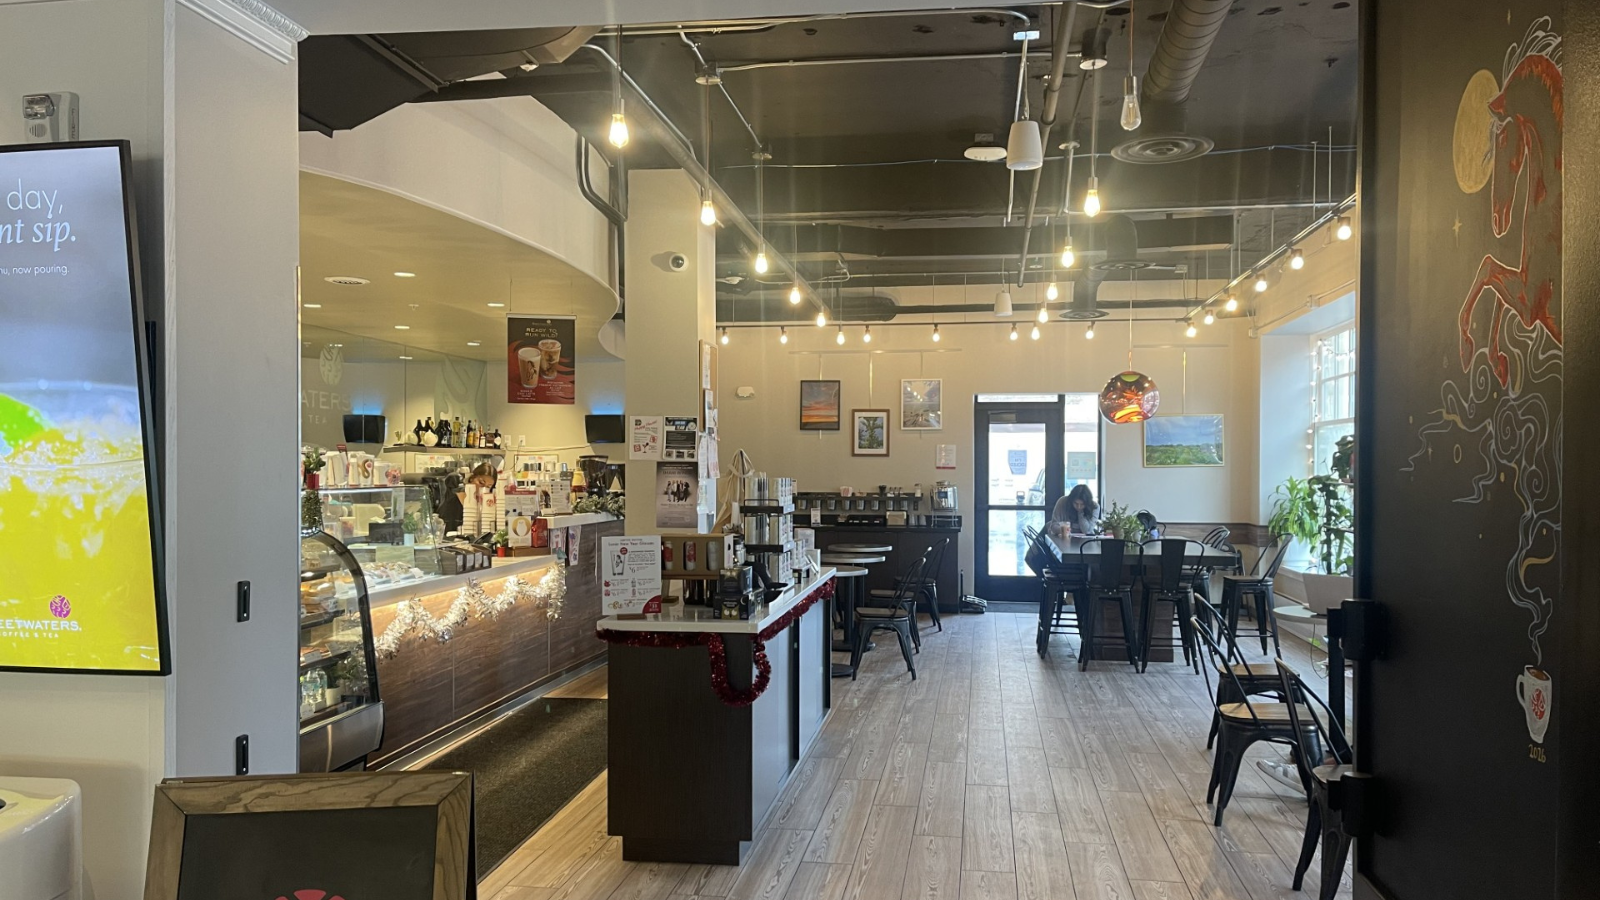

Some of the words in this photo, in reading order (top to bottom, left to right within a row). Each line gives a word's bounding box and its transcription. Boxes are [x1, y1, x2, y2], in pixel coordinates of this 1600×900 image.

[7, 178, 63, 217] day,
[0, 219, 25, 244] nt
[32, 213, 76, 252] sip.
[12, 266, 32, 275] now
[34, 264, 70, 277] pouring.
[301, 389, 352, 412] ATERS
[308, 414, 328, 425] TEA
[1528, 743, 1547, 763] 2026
